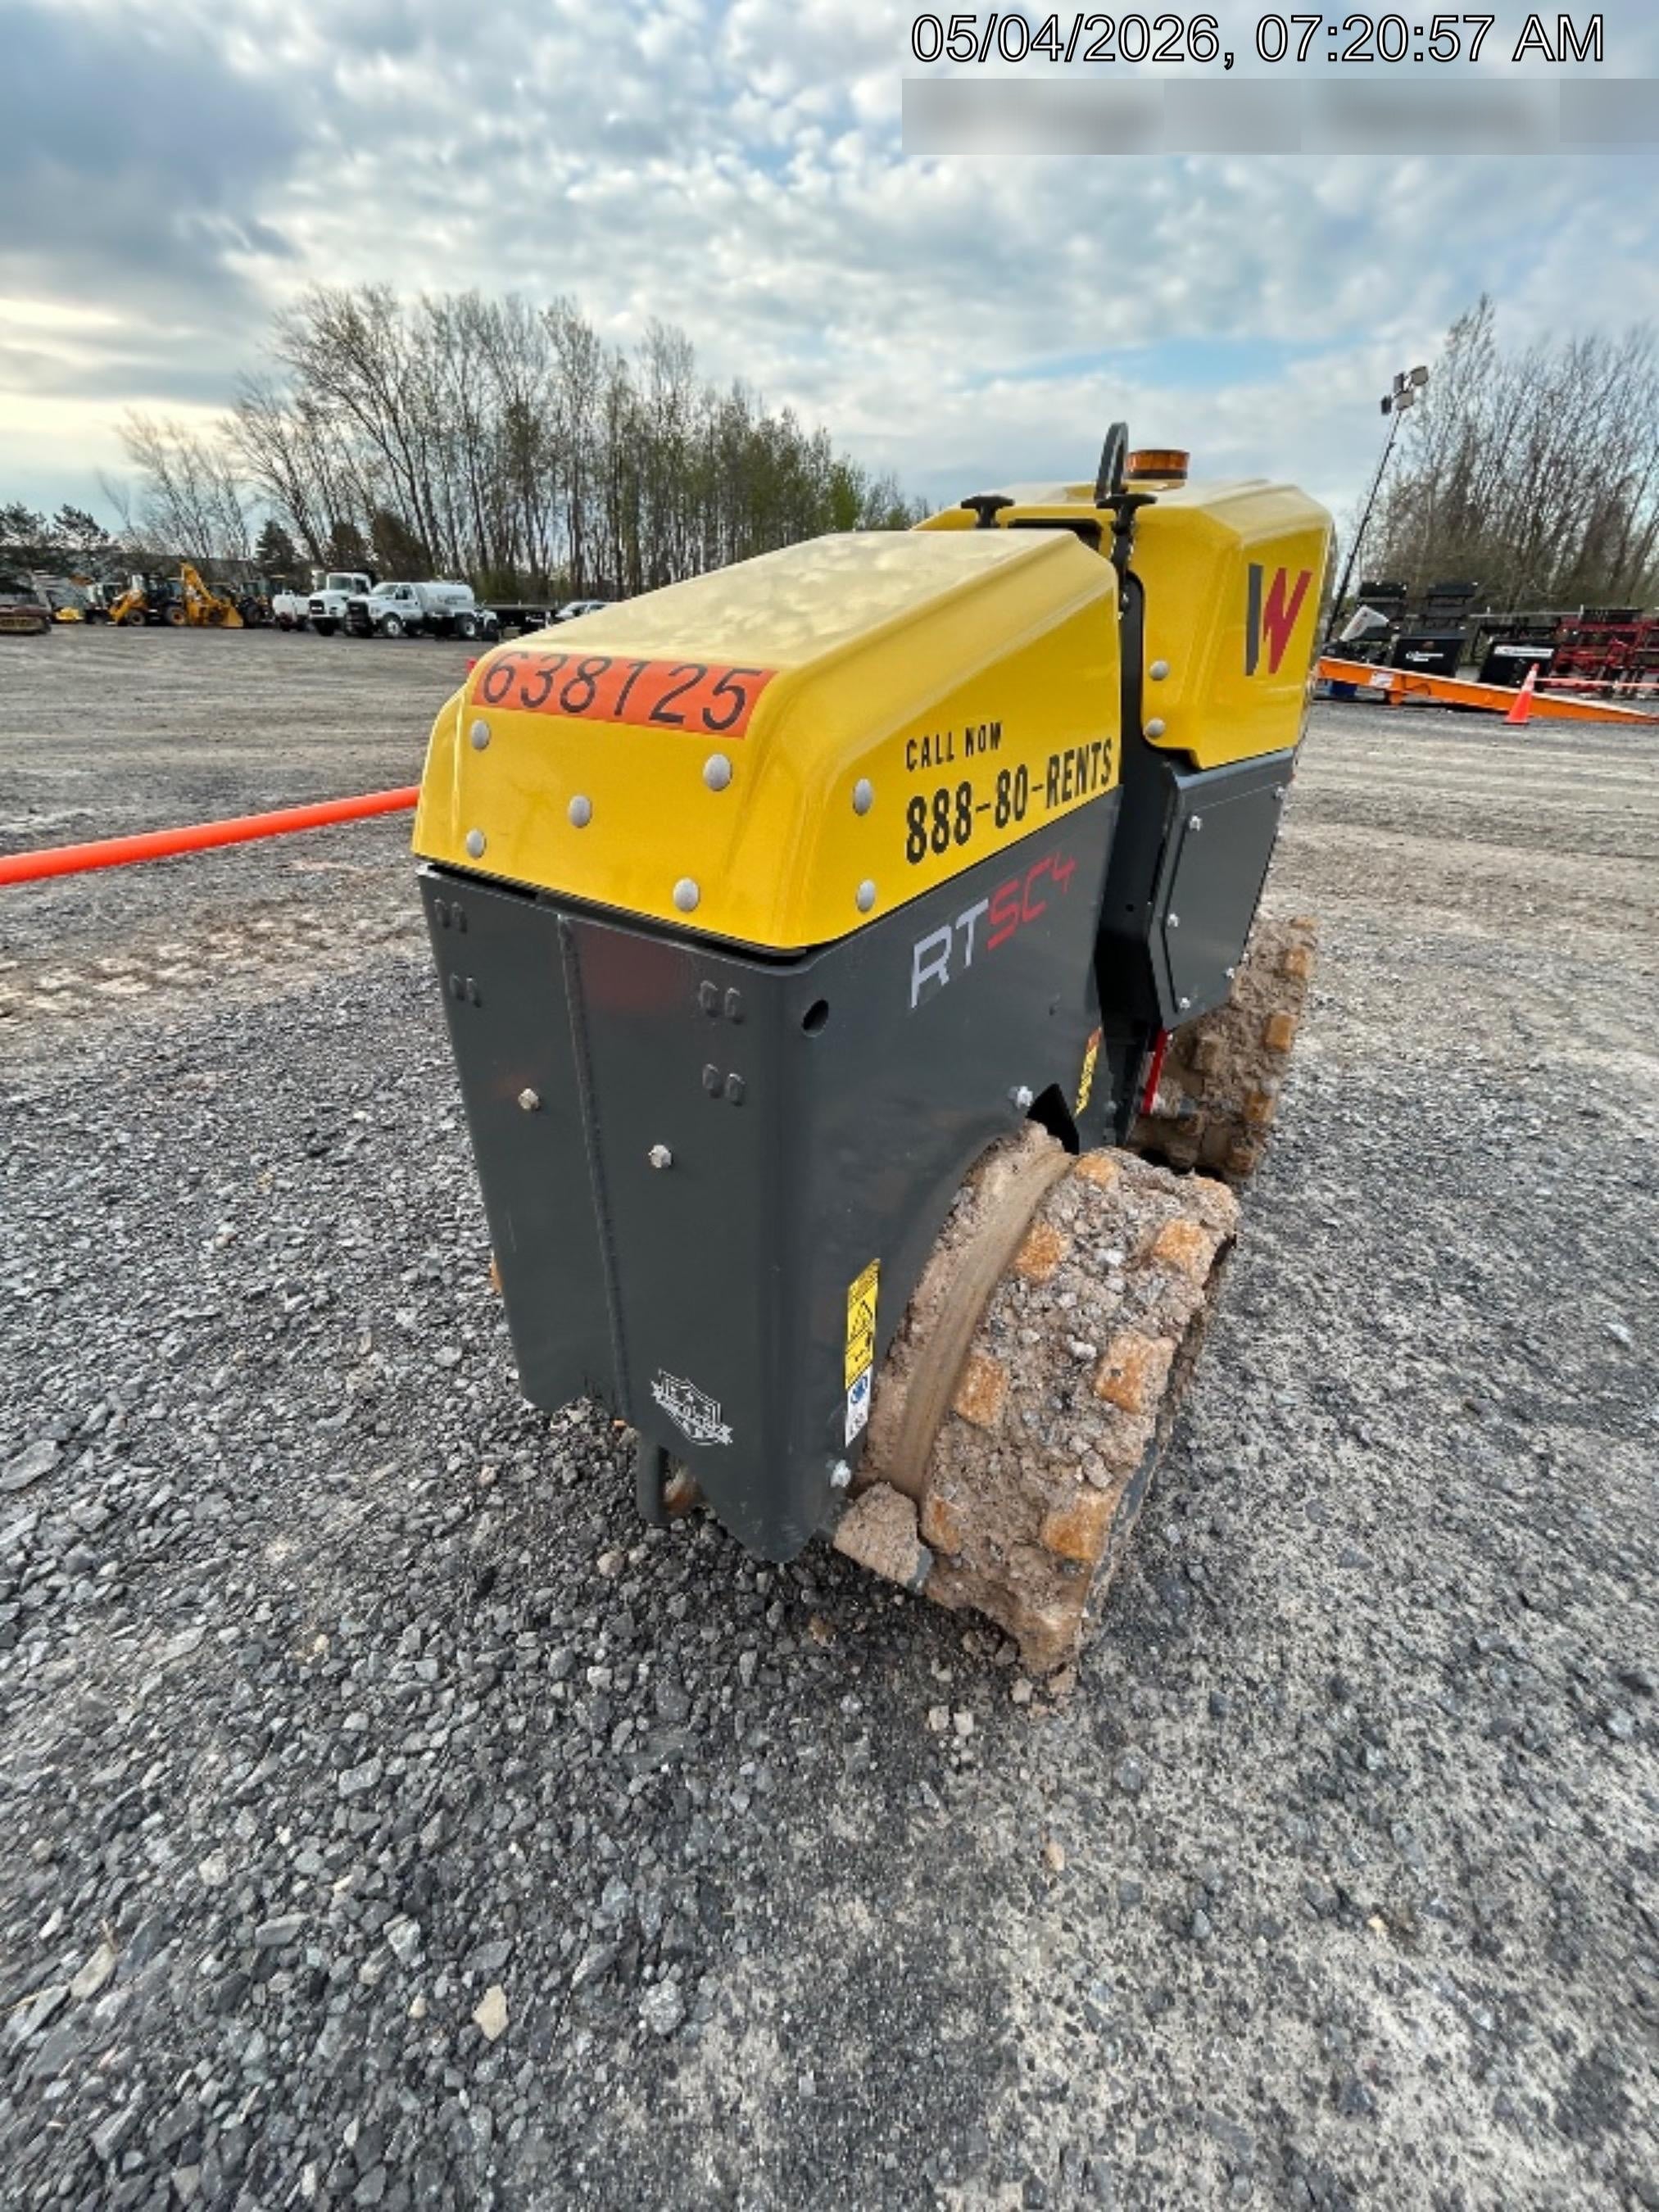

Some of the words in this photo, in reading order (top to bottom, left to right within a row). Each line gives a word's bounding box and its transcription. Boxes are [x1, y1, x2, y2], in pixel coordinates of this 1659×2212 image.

[483, 650, 763, 731] 638125
[906, 731, 955, 772] CALL
[965, 721, 1003, 757] NOW
[906, 737, 1113, 865] 888-80-RENTS
